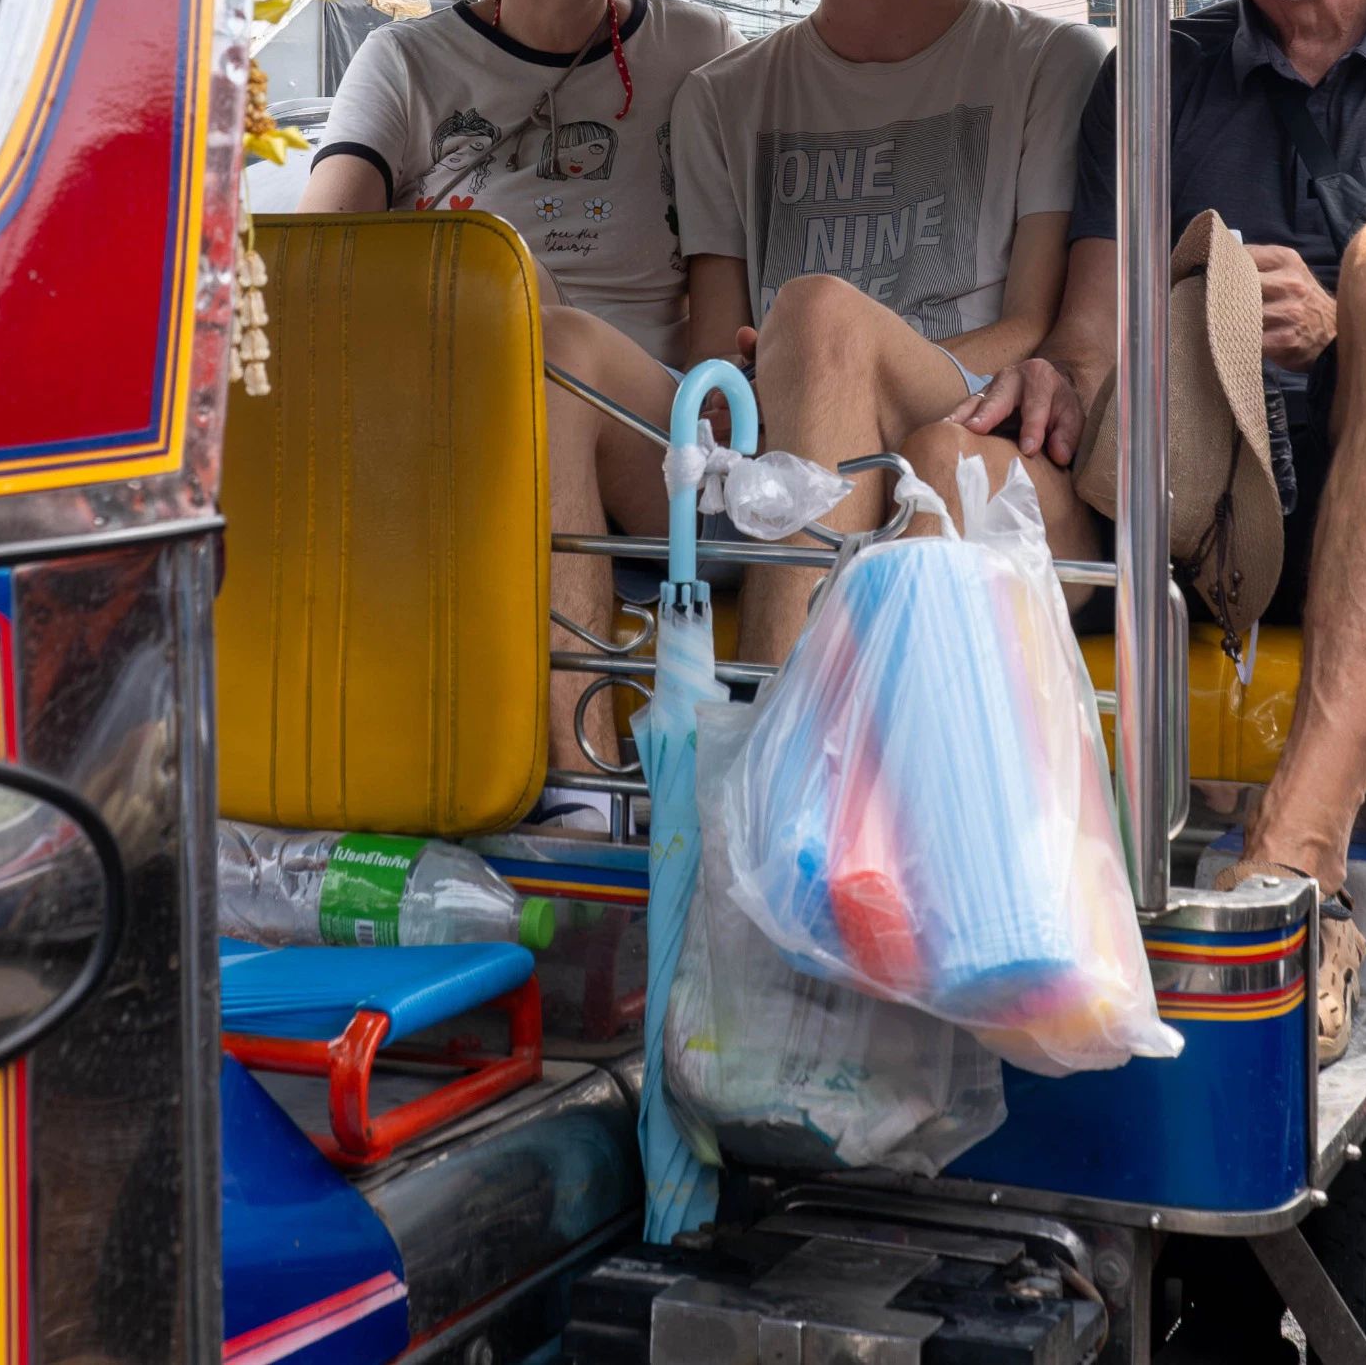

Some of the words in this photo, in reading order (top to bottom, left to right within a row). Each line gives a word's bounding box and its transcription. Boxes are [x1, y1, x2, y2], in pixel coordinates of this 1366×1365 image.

[776, 140, 896, 205] ONE
[547, 242, 600, 257] daisy
[576, 228, 600, 240] the
[802, 191, 946, 272] NINE
